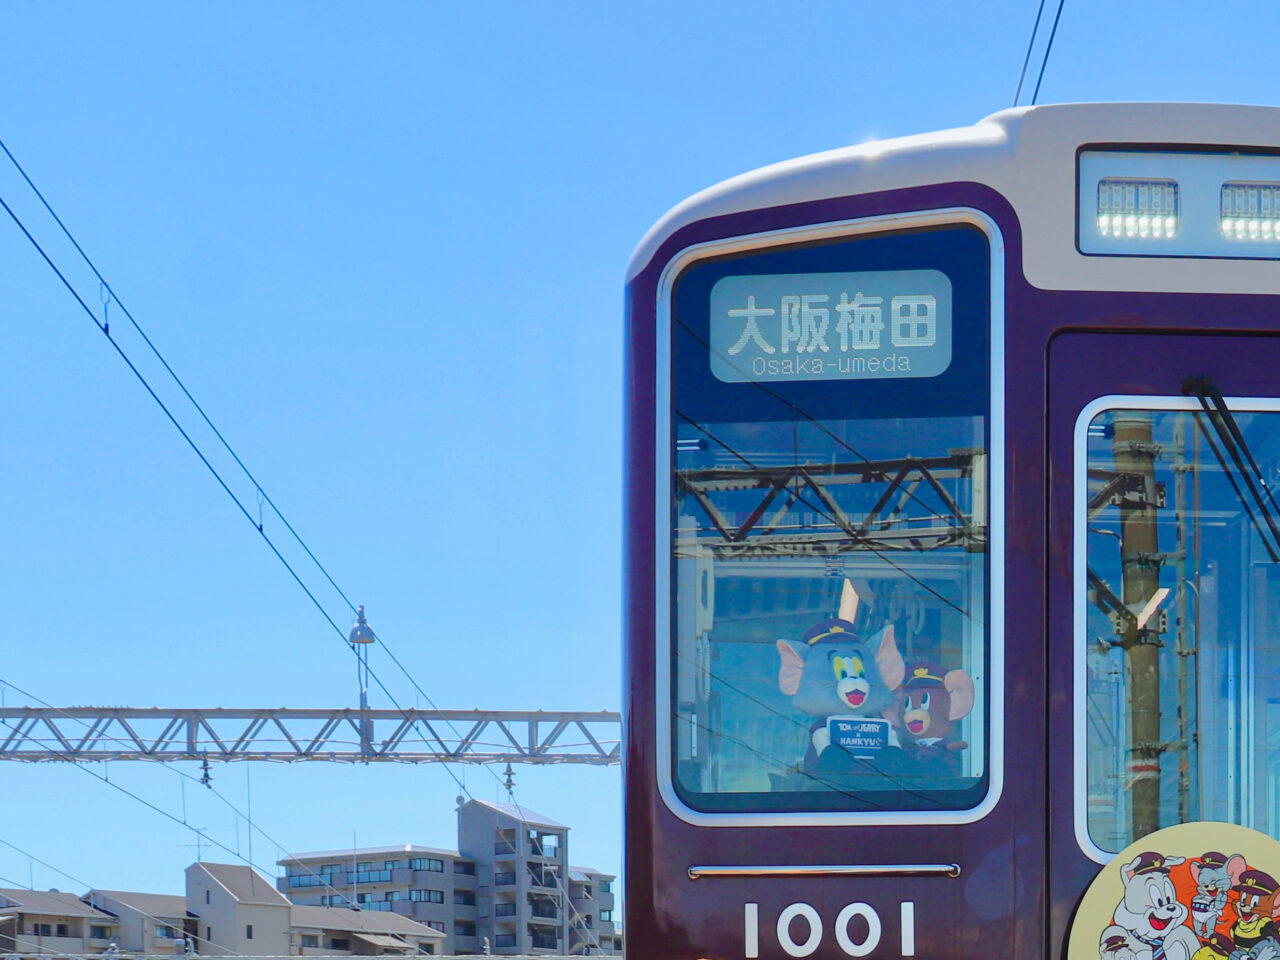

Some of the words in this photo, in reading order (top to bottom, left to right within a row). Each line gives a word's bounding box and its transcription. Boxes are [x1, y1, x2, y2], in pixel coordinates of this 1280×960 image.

[727, 291, 937, 355] 大阪梅田
[752, 353, 912, 376] Osaka-umeda
[744, 901, 915, 959] 1001
